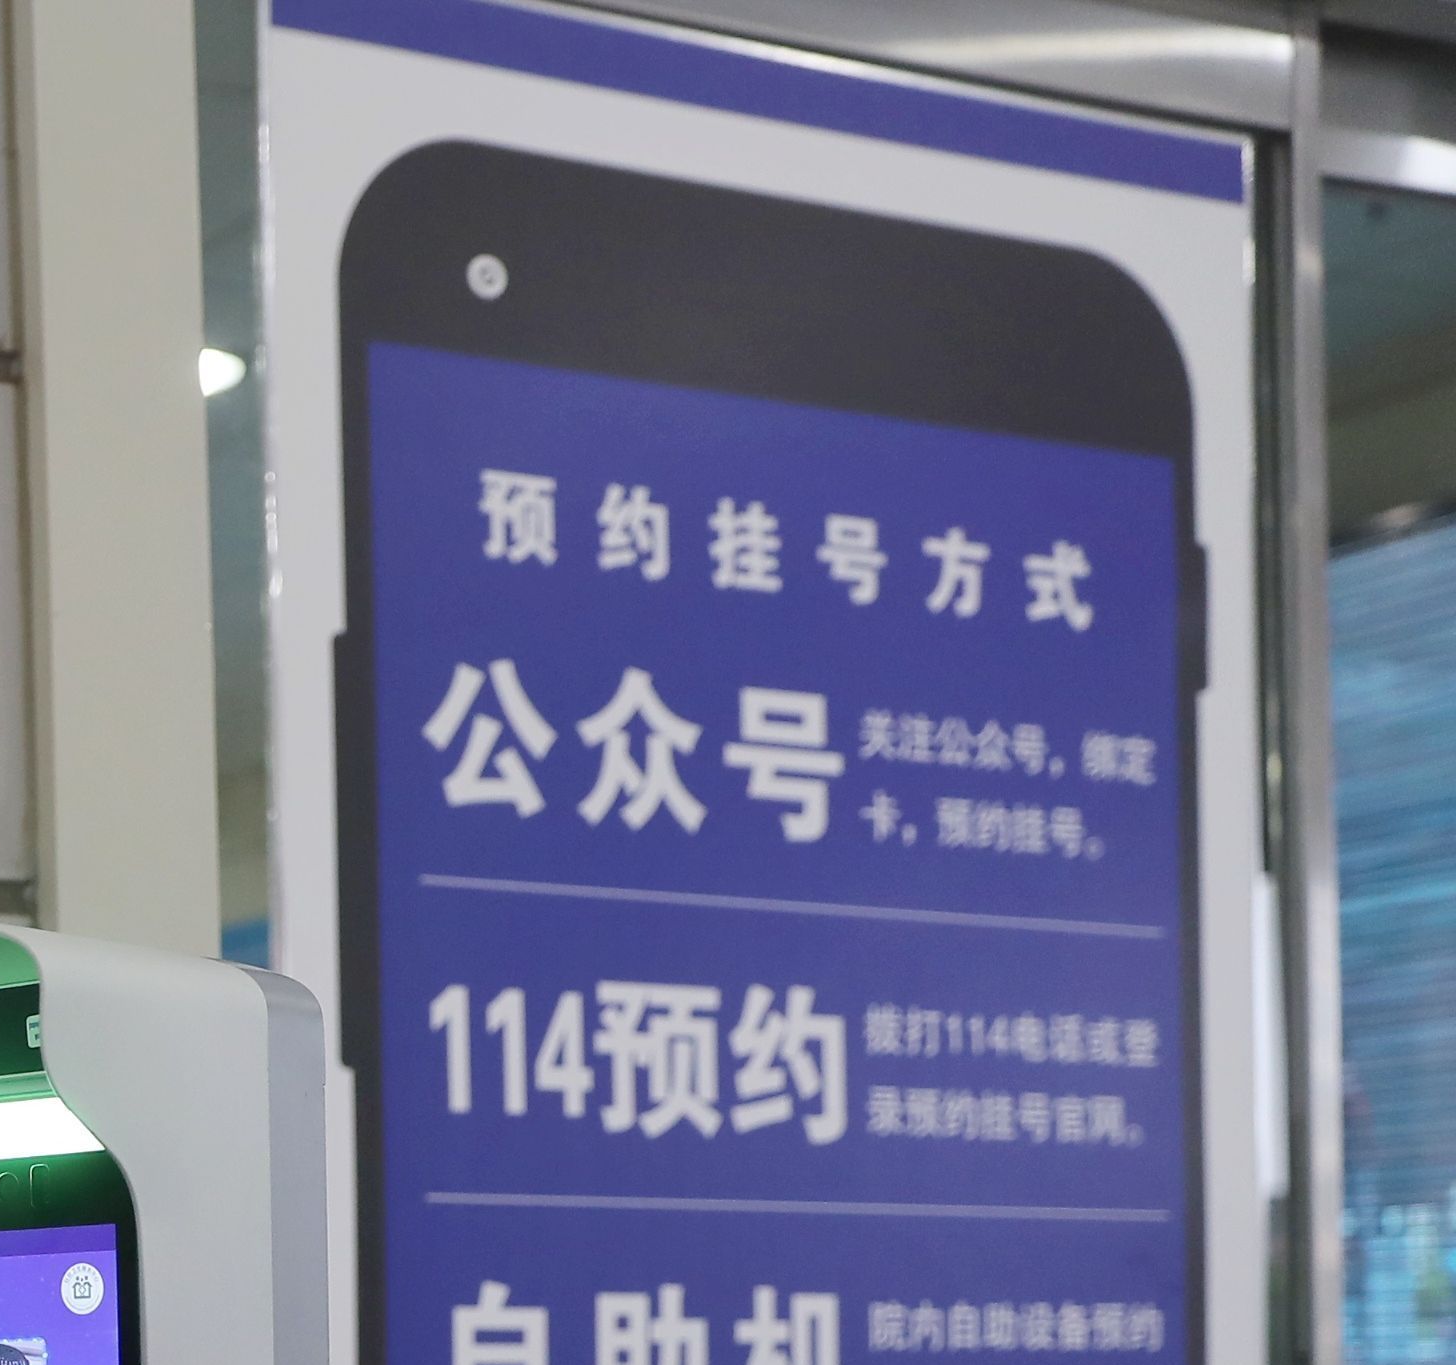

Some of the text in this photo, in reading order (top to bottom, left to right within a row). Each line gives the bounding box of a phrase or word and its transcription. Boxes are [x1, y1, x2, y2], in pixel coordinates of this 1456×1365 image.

[479, 468, 1093, 631] 预约挂号方式
[421, 658, 845, 843] 公众号
[429, 980, 848, 1144] 114预约
[867, 1300, 1165, 1355] 院内自助设备预约
